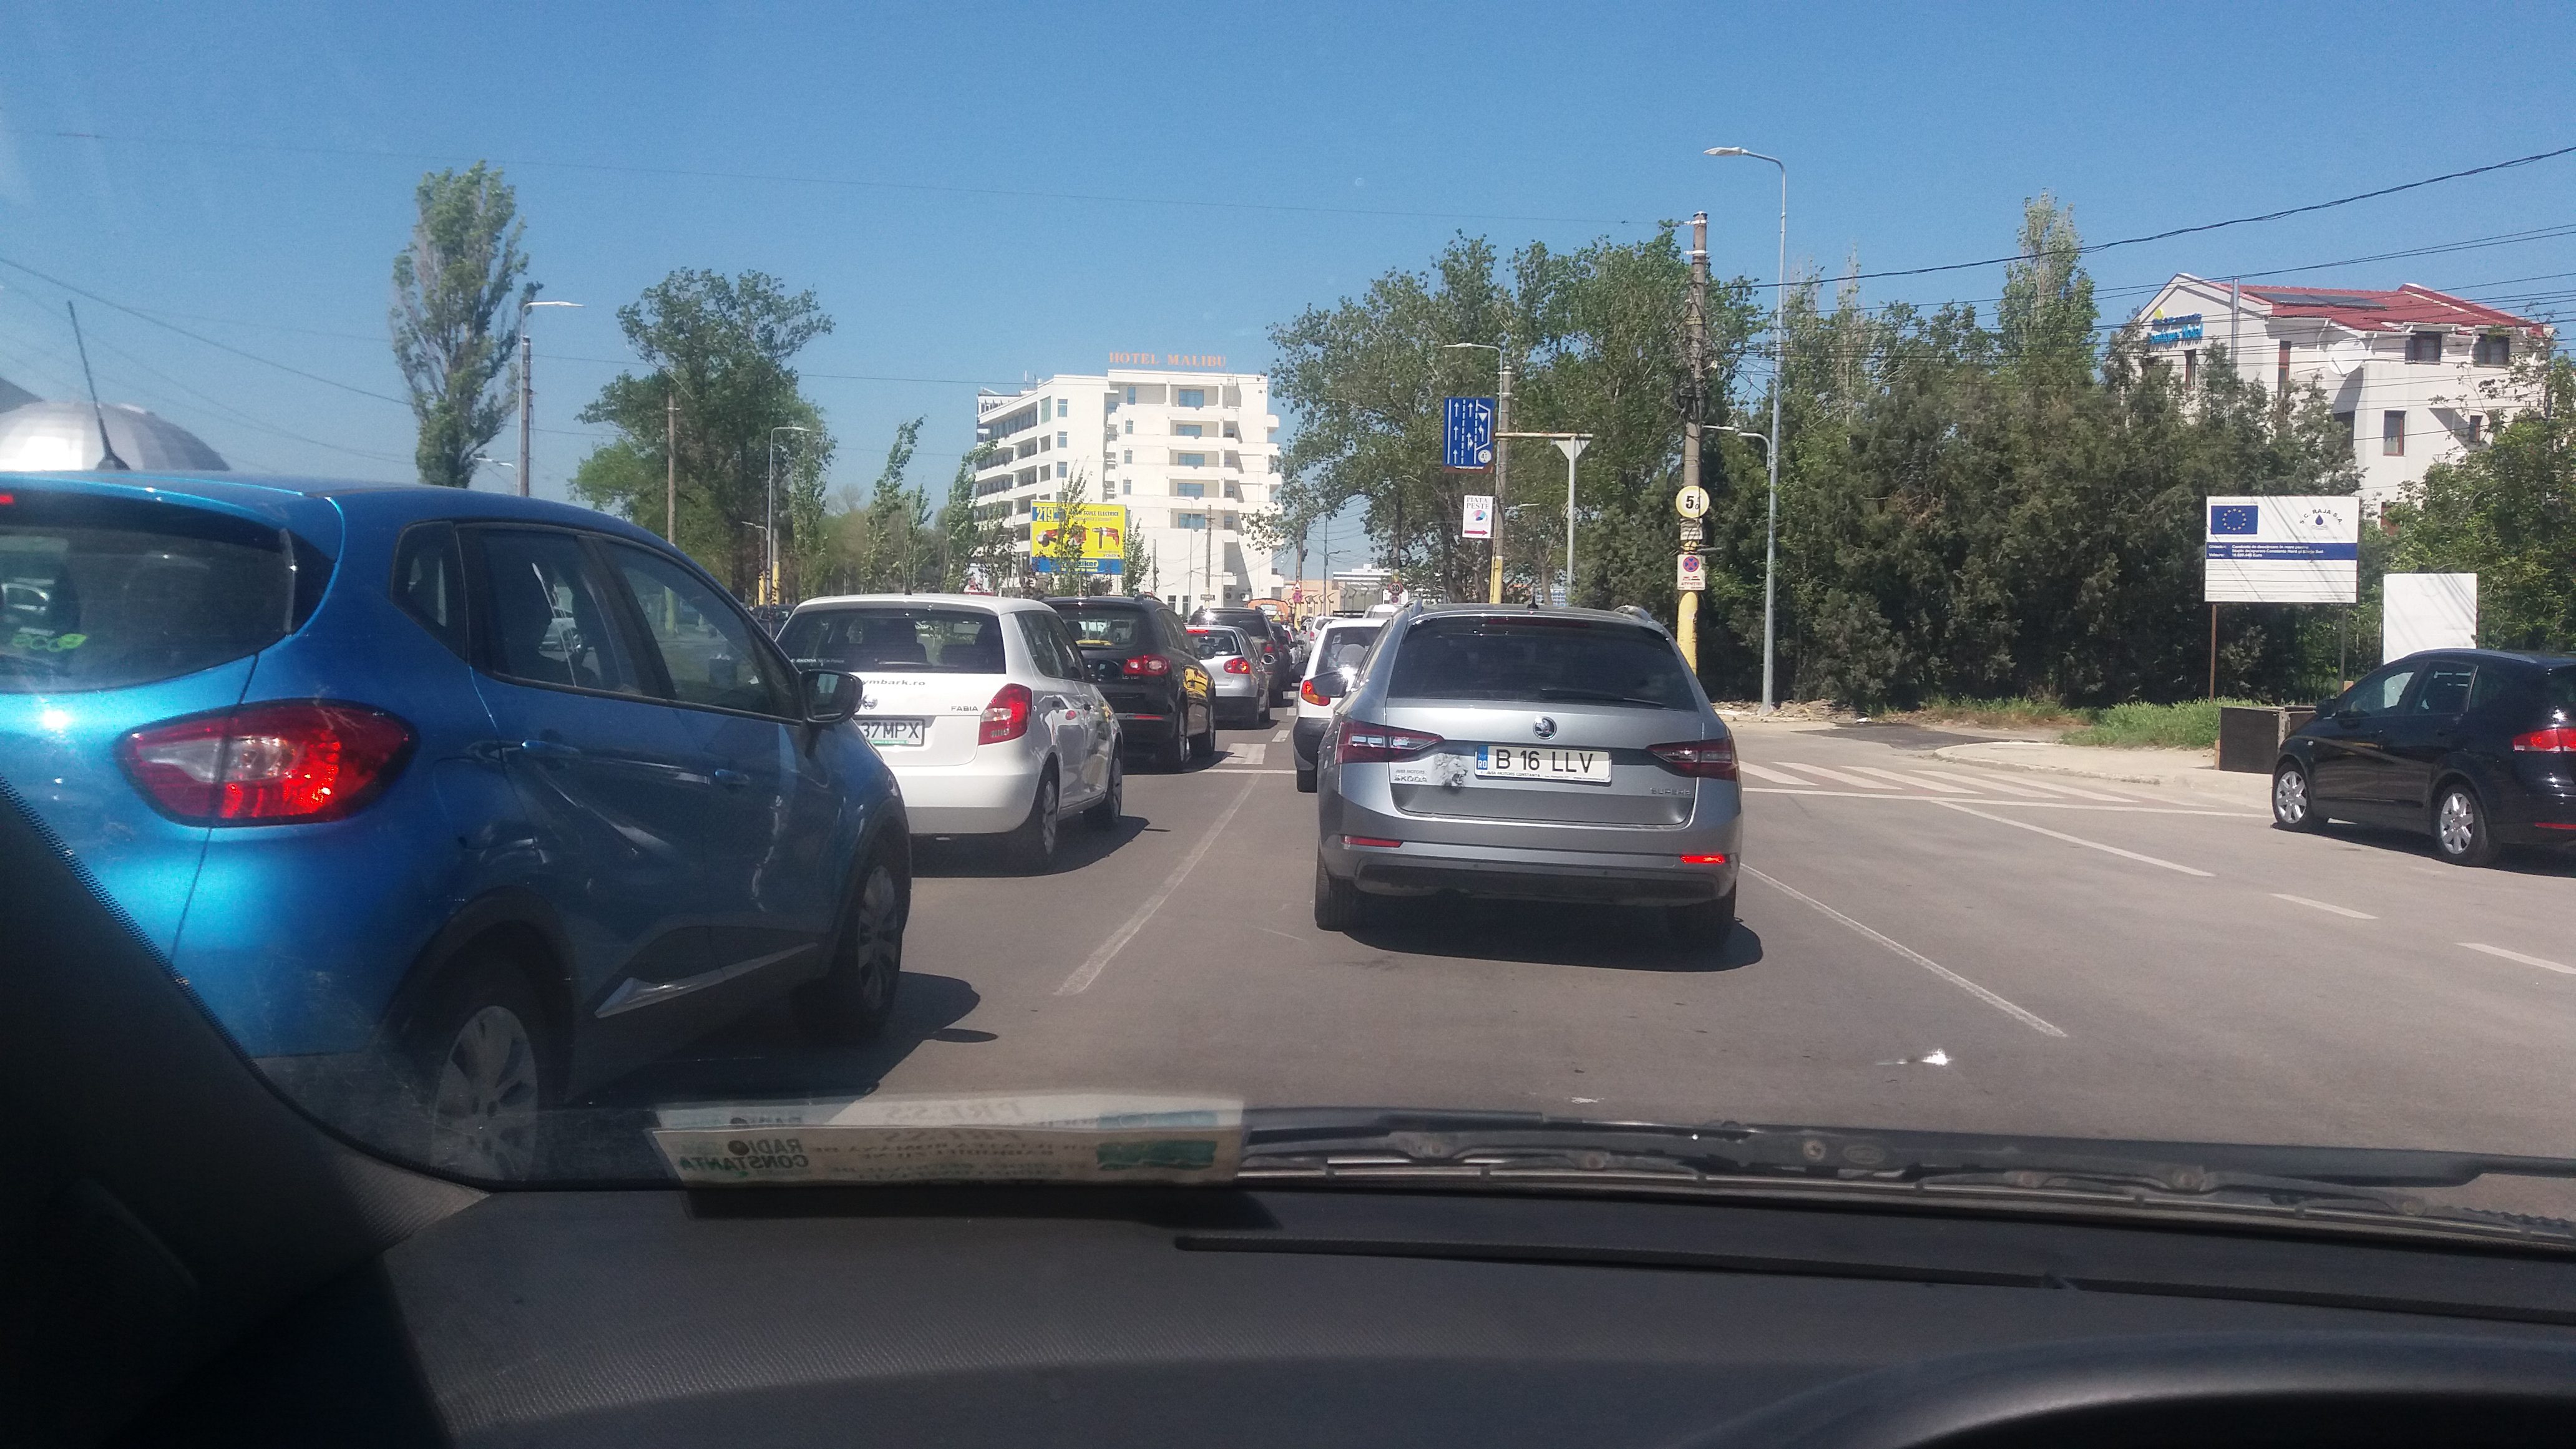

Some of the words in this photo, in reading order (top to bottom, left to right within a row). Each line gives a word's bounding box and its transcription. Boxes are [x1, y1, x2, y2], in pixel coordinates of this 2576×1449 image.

[1109, 352, 1159, 365] HOTEL
[1168, 354, 1227, 368] MALIBU
[1037, 507, 1053, 522] 219
[1478, 759, 1487, 769] RO
[1496, 749, 1511, 769] B
[1520, 750, 1540, 771] 16
[1551, 751, 1593, 773] LLV
